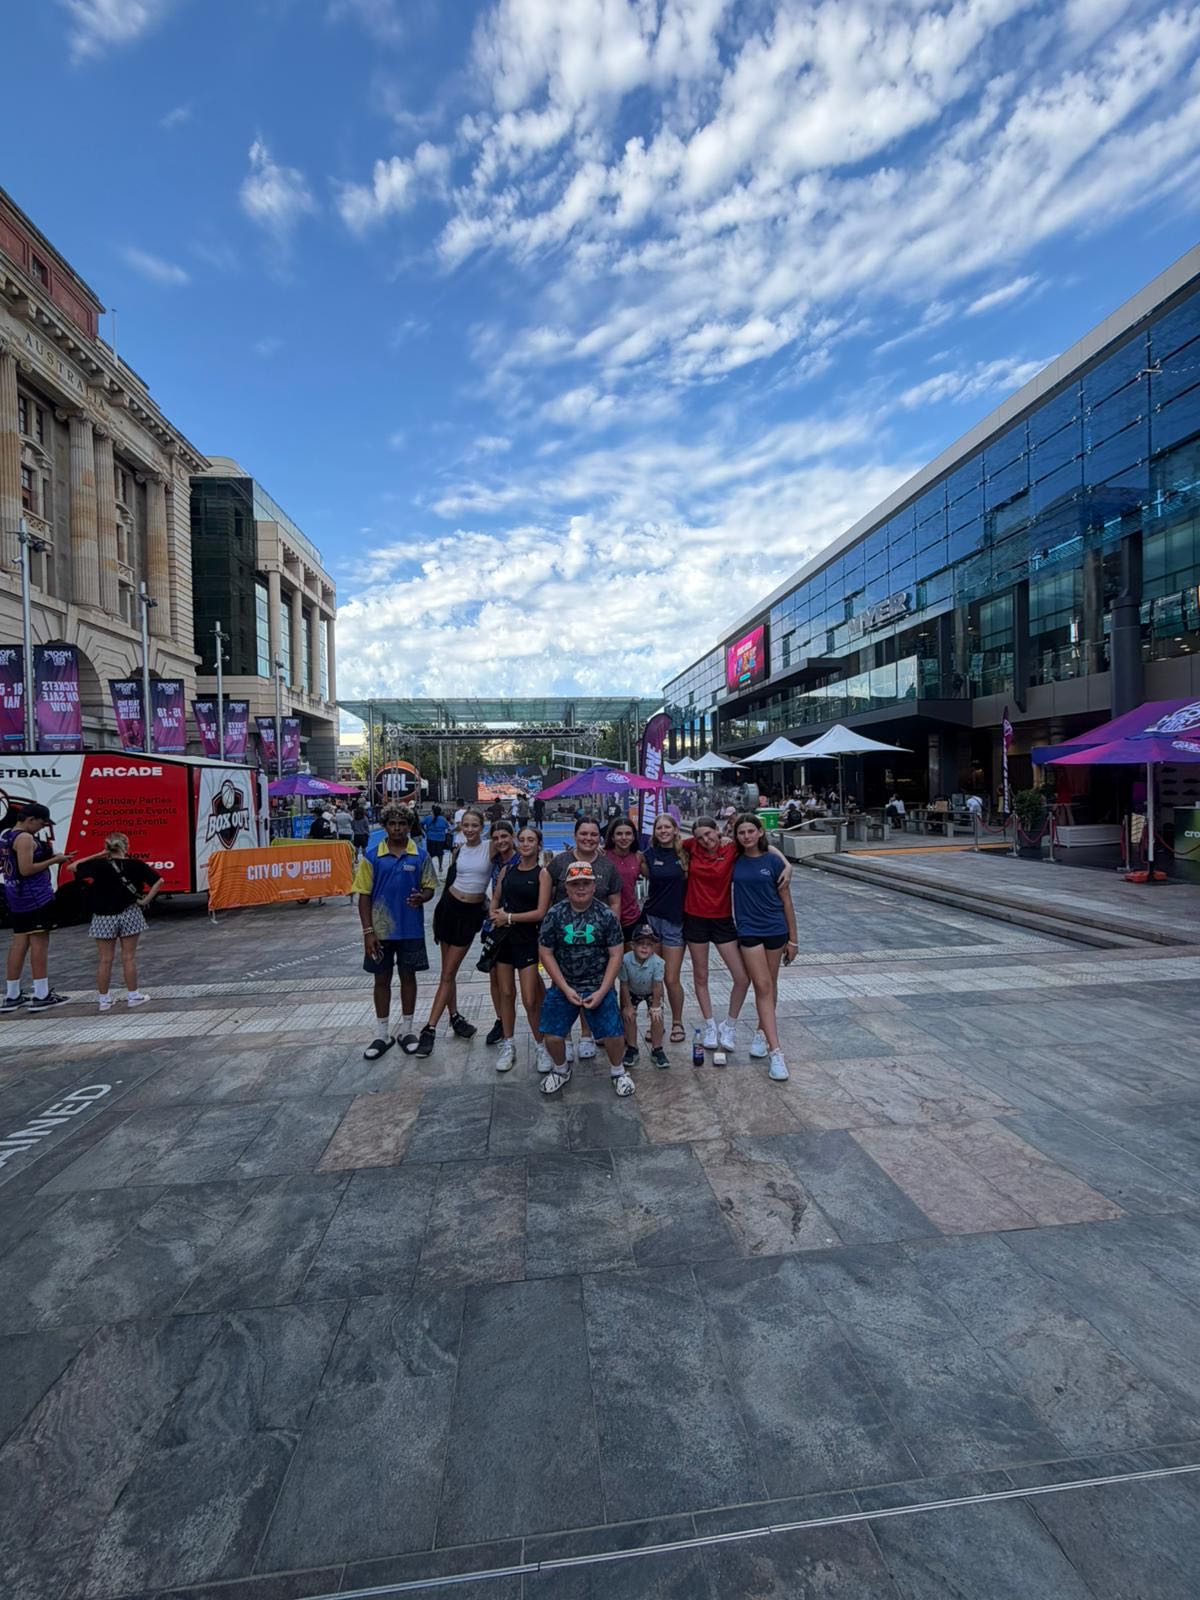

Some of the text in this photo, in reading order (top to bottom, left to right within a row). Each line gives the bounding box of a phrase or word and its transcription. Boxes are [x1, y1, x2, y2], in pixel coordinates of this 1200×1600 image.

[25, 333, 105, 411] AUSTRALIA
[848, 592, 907, 636] MYER
[13, 683, 23, 695] 18
[90, 766, 163, 777] ARCADE
[97, 796, 172, 805] Birthday Parties
[95, 806, 177, 816] Corporate Events
[93, 817, 168, 827] Sporting Events
[209, 813, 231, 837] BOX
[231, 810, 249, 829] OUT
[247, 859, 331, 880] CITY OF PERTH
